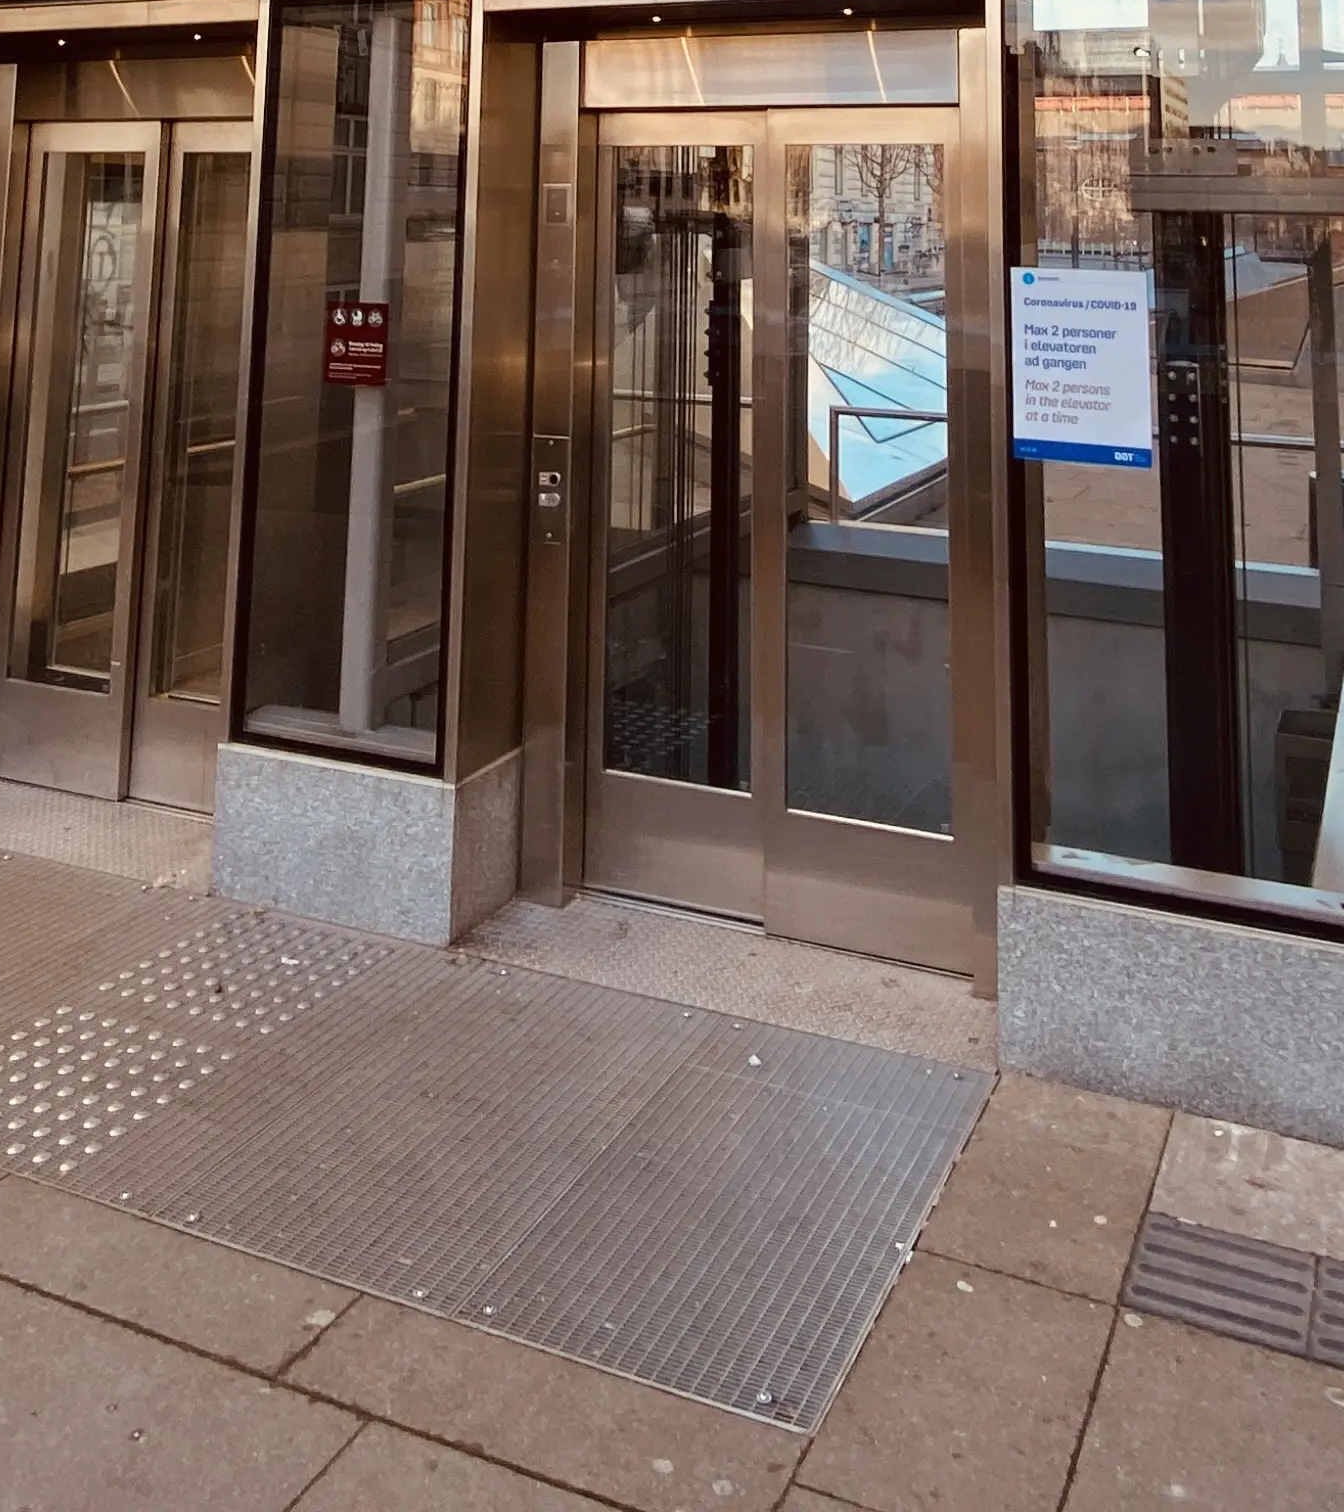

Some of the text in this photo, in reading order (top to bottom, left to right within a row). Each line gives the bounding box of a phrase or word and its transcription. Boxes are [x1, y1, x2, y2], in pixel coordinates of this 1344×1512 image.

[1023, 297, 1084, 309] Coronavirus
[1024, 324, 1117, 340] Max 2 personer
[1024, 338, 1097, 354] i elevatoren
[1024, 356, 1087, 371] ad gangen
[1025, 379, 1111, 396] Max 2 persons
[1025, 394, 1112, 411] in the elevator
[1025, 410, 1079, 425] at a time
